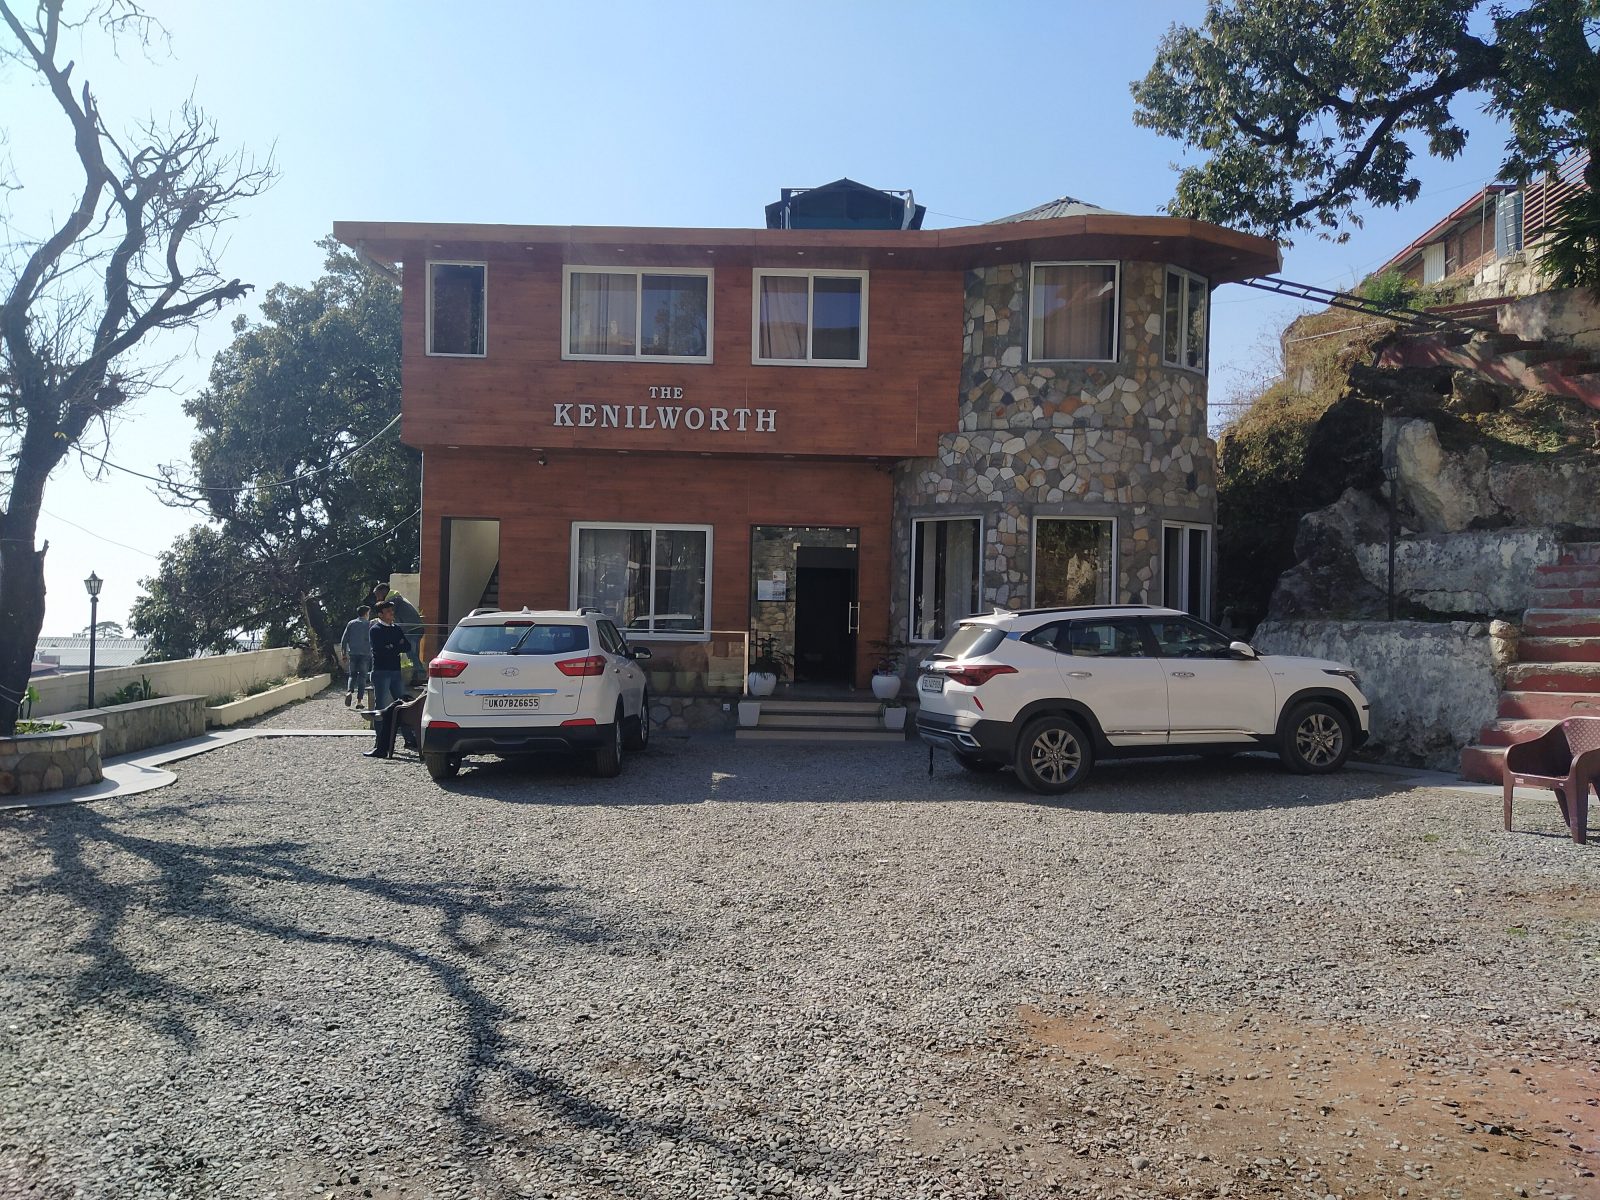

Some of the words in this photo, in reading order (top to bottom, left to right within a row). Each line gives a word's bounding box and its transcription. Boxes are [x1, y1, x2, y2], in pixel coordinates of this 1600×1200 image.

[649, 386, 683, 399] THE
[553, 403, 777, 432] KENILWORTH
[488, 699, 539, 708] UK07BZ6655
